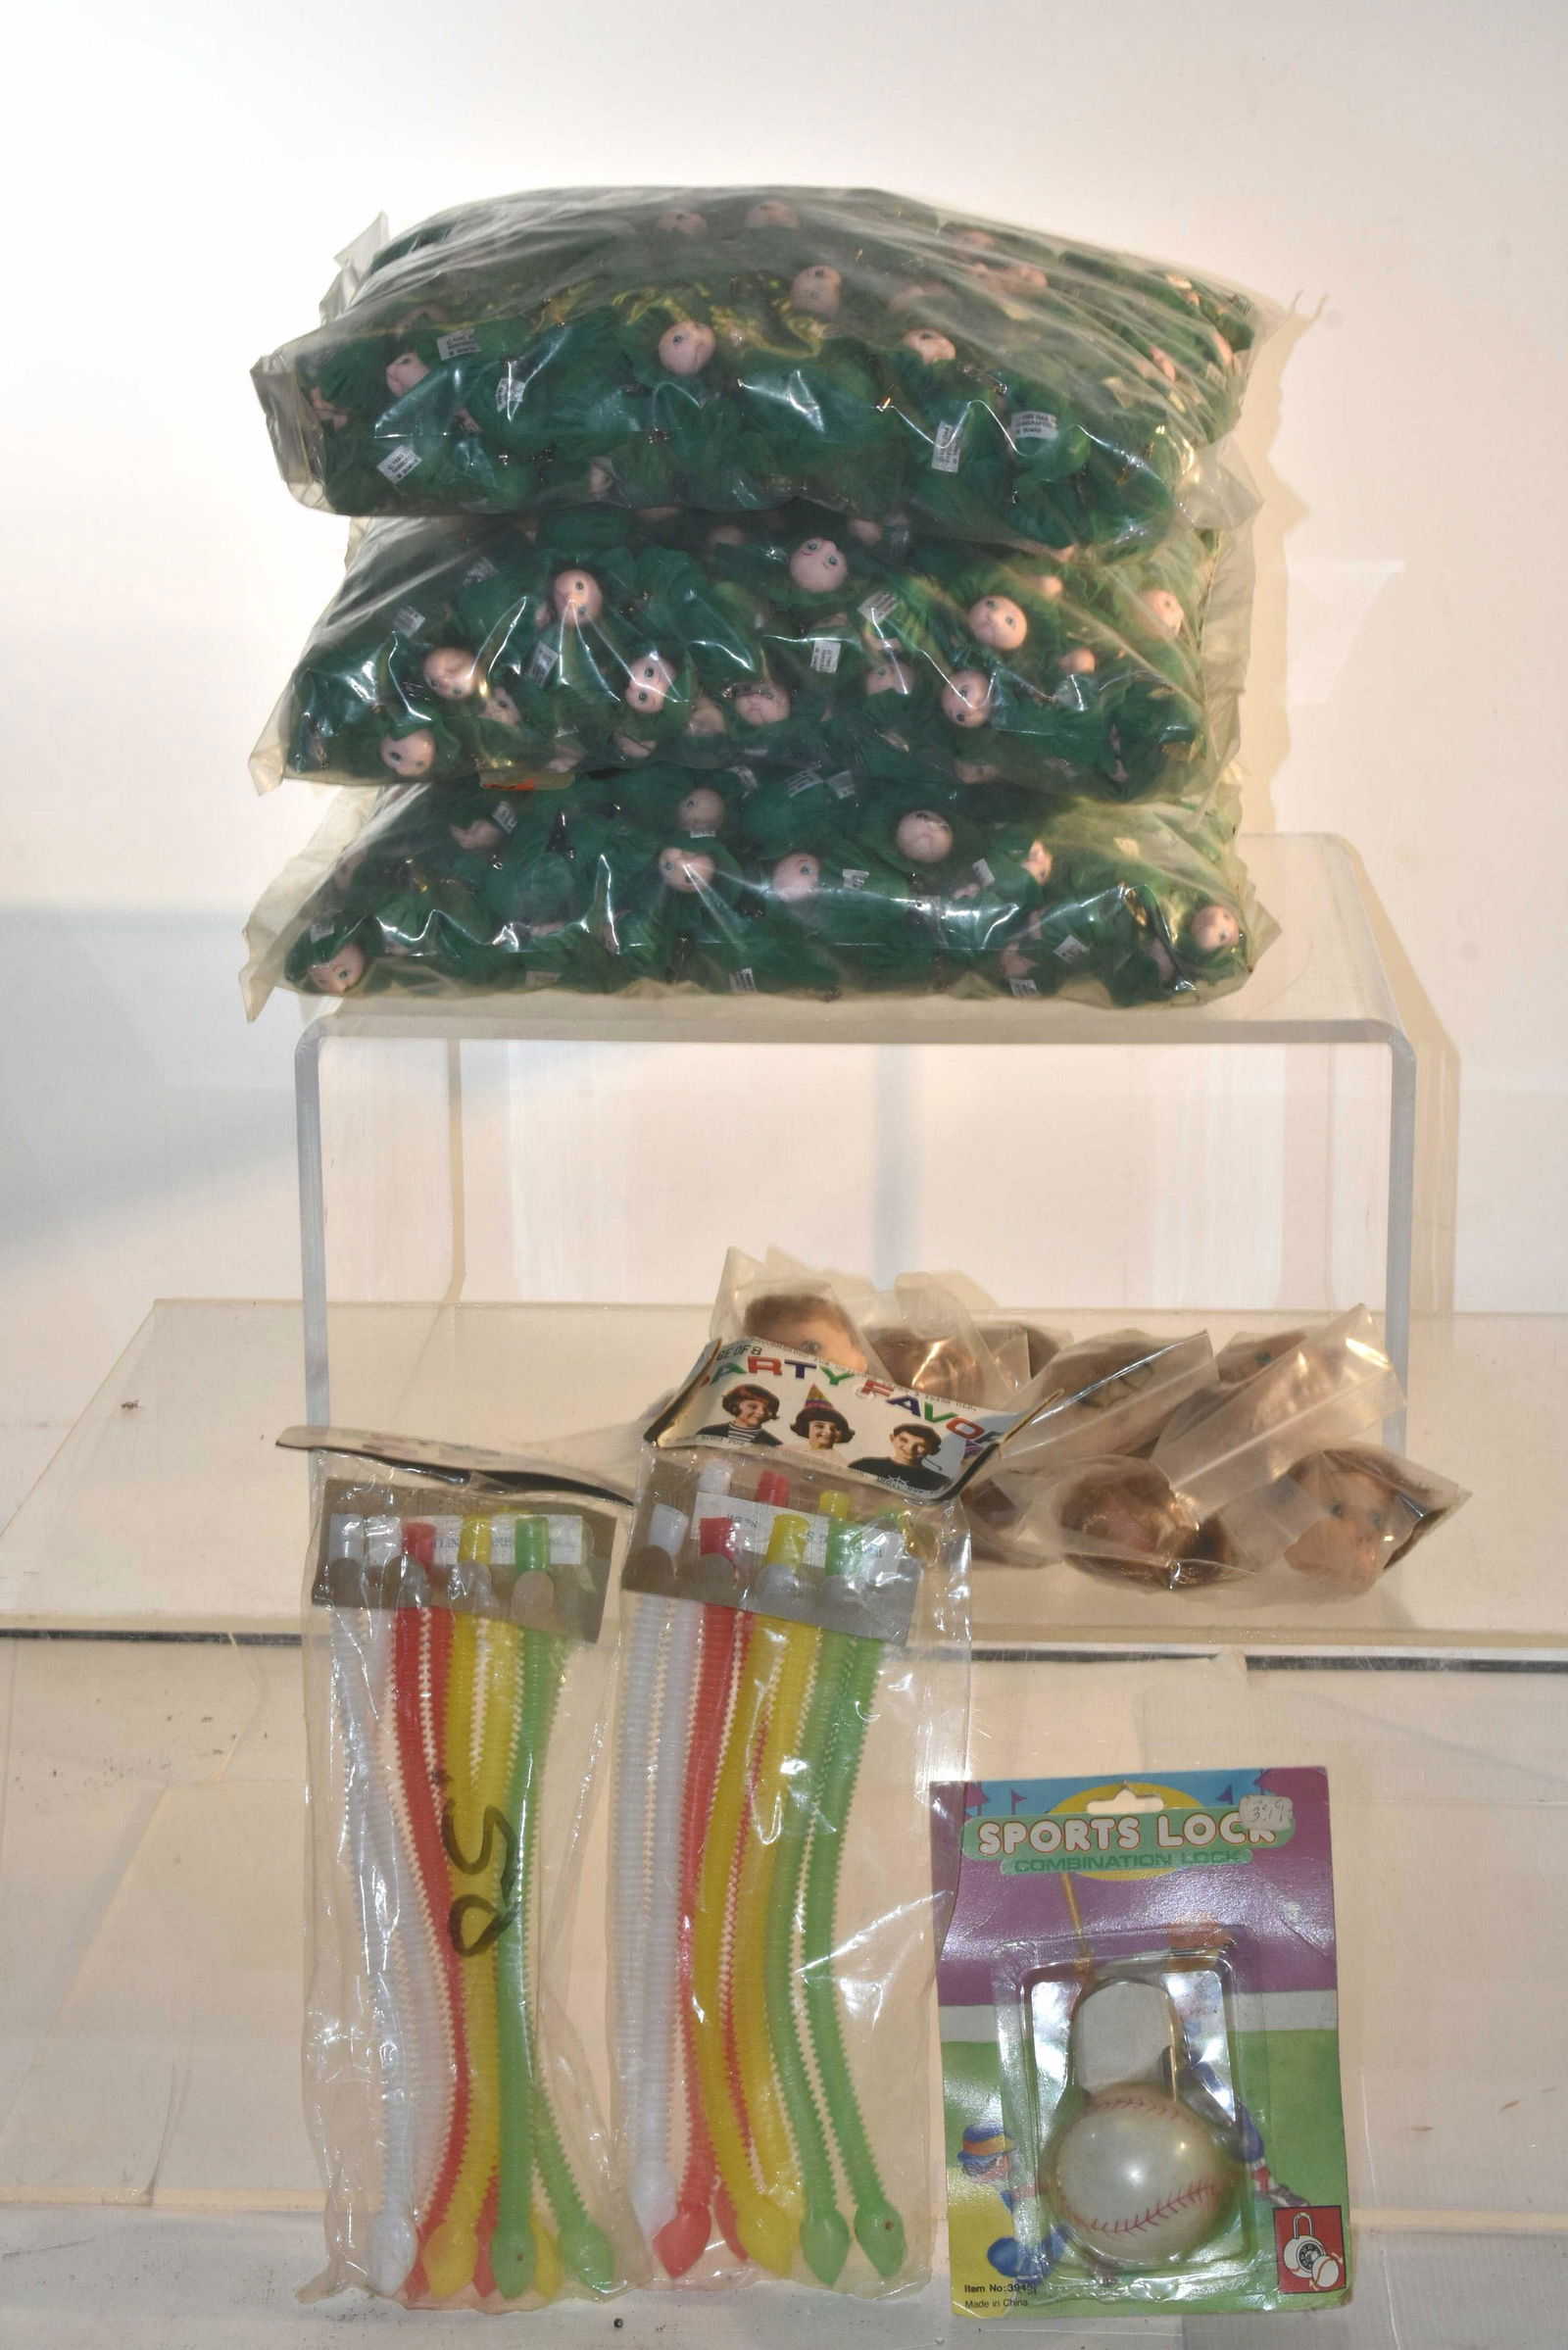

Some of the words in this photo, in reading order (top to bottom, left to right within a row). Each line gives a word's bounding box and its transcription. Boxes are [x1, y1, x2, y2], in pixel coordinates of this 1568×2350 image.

[733, 1344, 753, 1356] OF
[750, 1346, 762, 1356] 8
[702, 1355, 856, 1387] ARTY
[977, 1816, 1142, 1856] SPORTS
[1013, 1852, 1173, 1873] COMBINATION
[1180, 1849, 1245, 1866] LOCK
[964, 2284, 986, 2293] Item
[964, 2300, 990, 2309] Made
[1003, 2298, 1029, 2308] China
